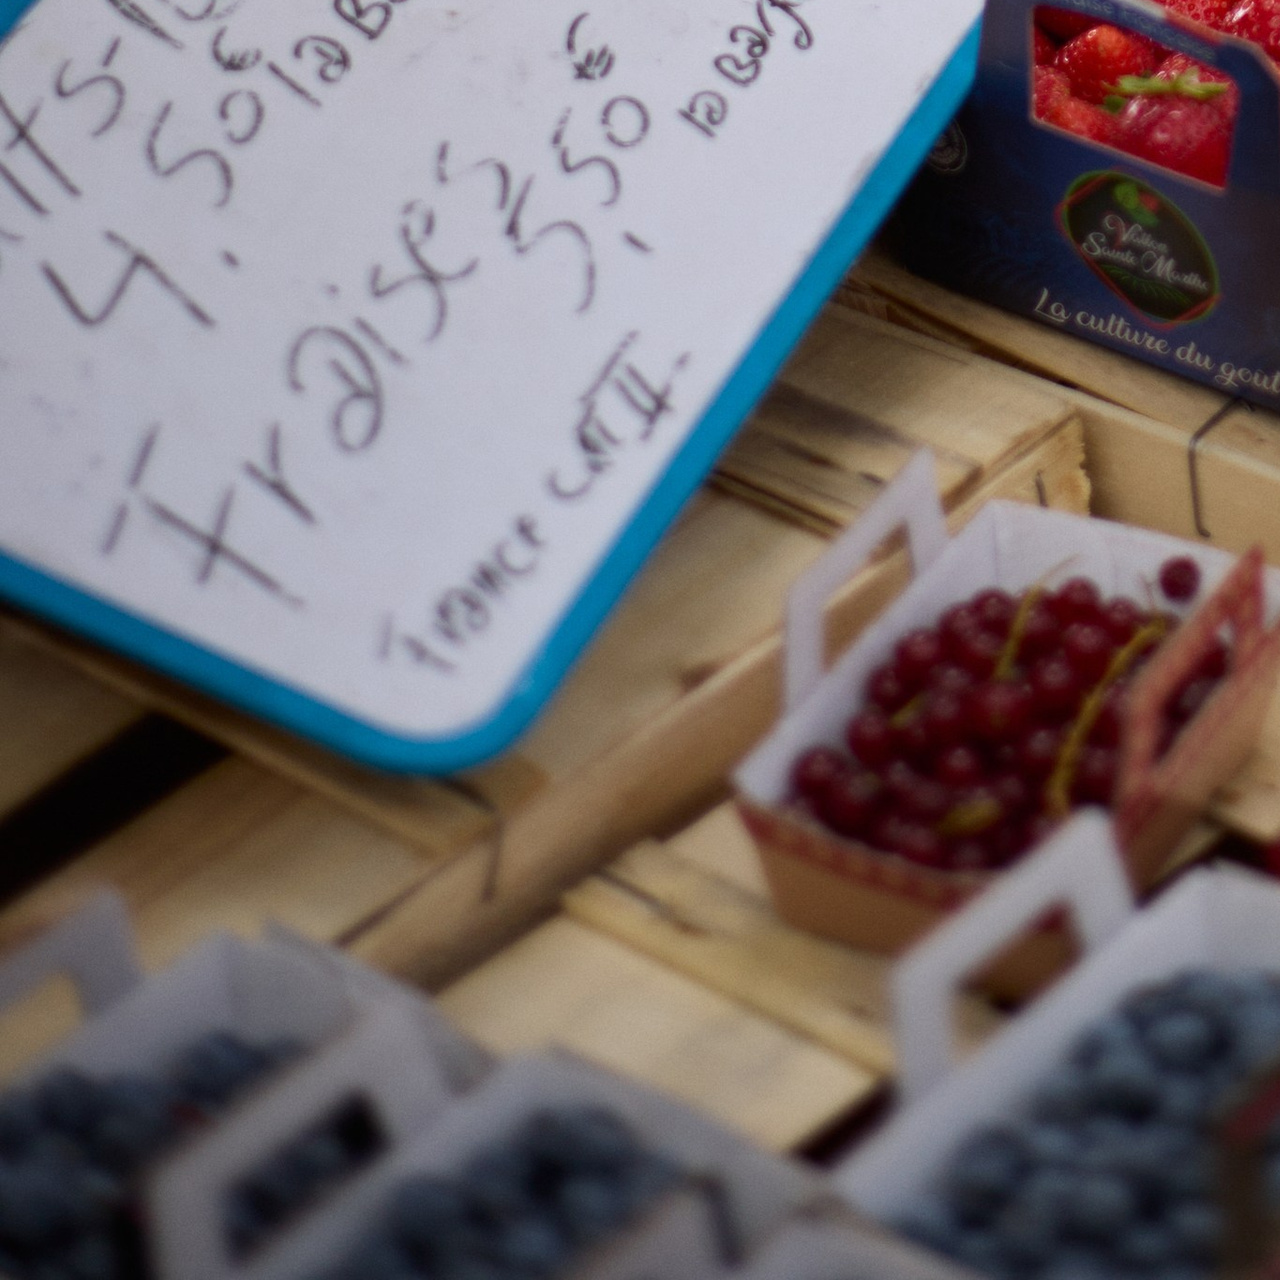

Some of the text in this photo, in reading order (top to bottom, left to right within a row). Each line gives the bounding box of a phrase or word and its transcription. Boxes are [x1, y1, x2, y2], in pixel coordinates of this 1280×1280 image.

[1034, 287, 1072, 323] La
[1076, 311, 1171, 354] culture
[1175, 341, 1216, 371] du
